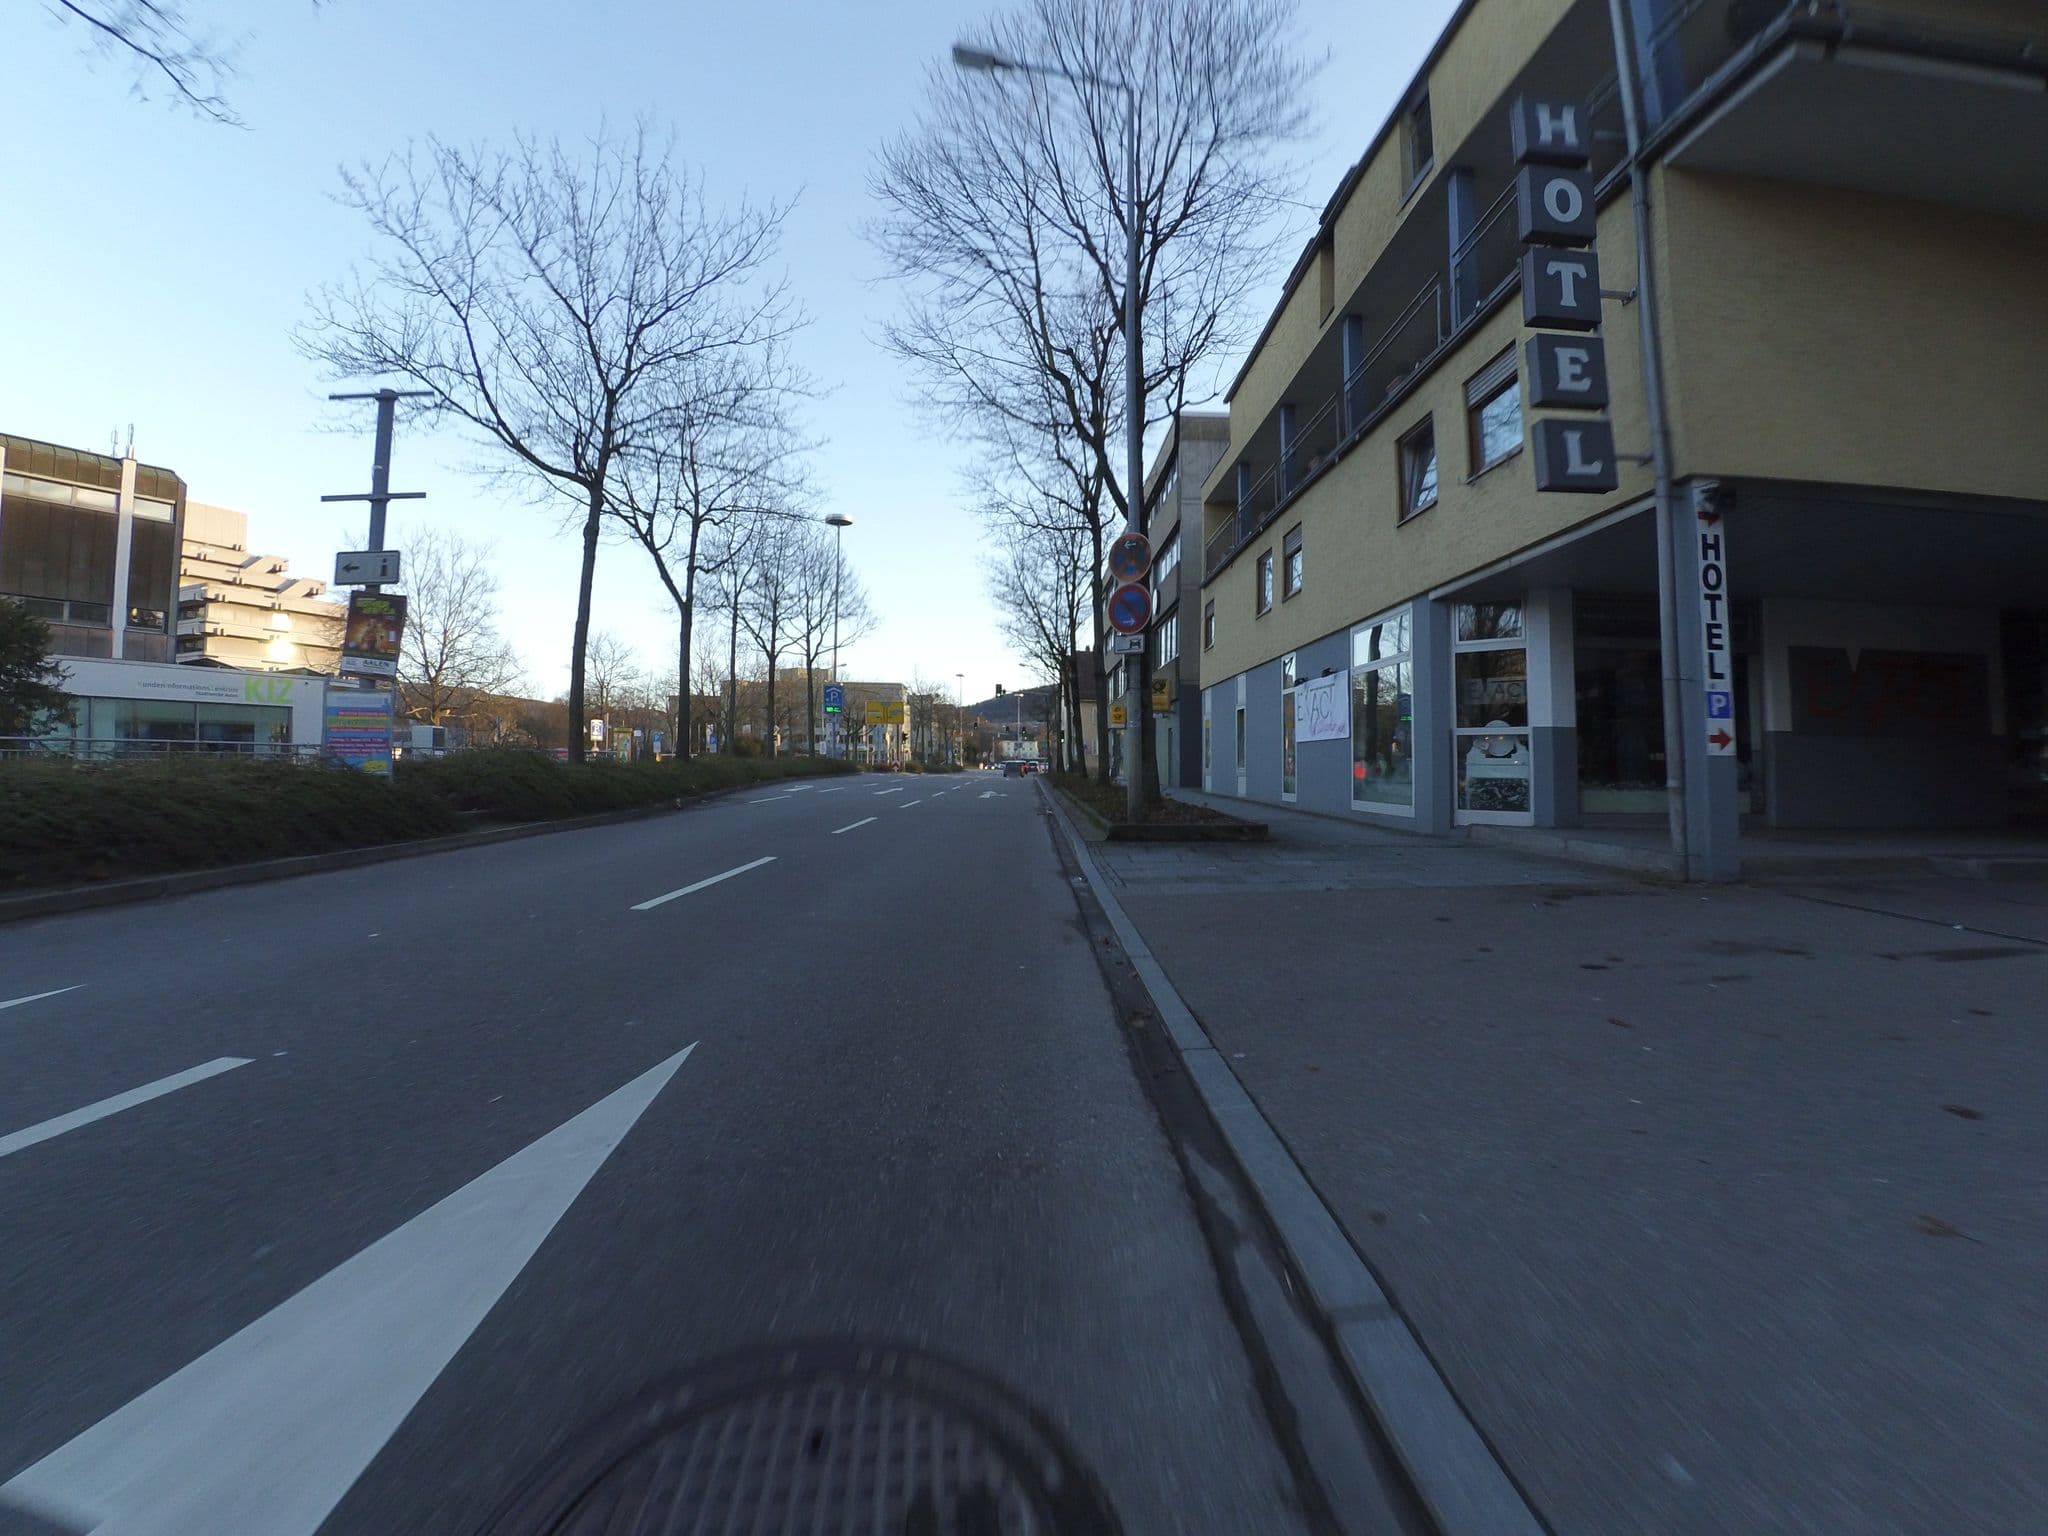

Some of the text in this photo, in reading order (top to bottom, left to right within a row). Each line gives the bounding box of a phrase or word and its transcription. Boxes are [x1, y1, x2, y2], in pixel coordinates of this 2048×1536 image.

[1535, 102, 1602, 477] HOTEL
[1701, 533, 1725, 680] HOTEL
[243, 676, 294, 705] KIZ
[1711, 694, 1727, 716] P
